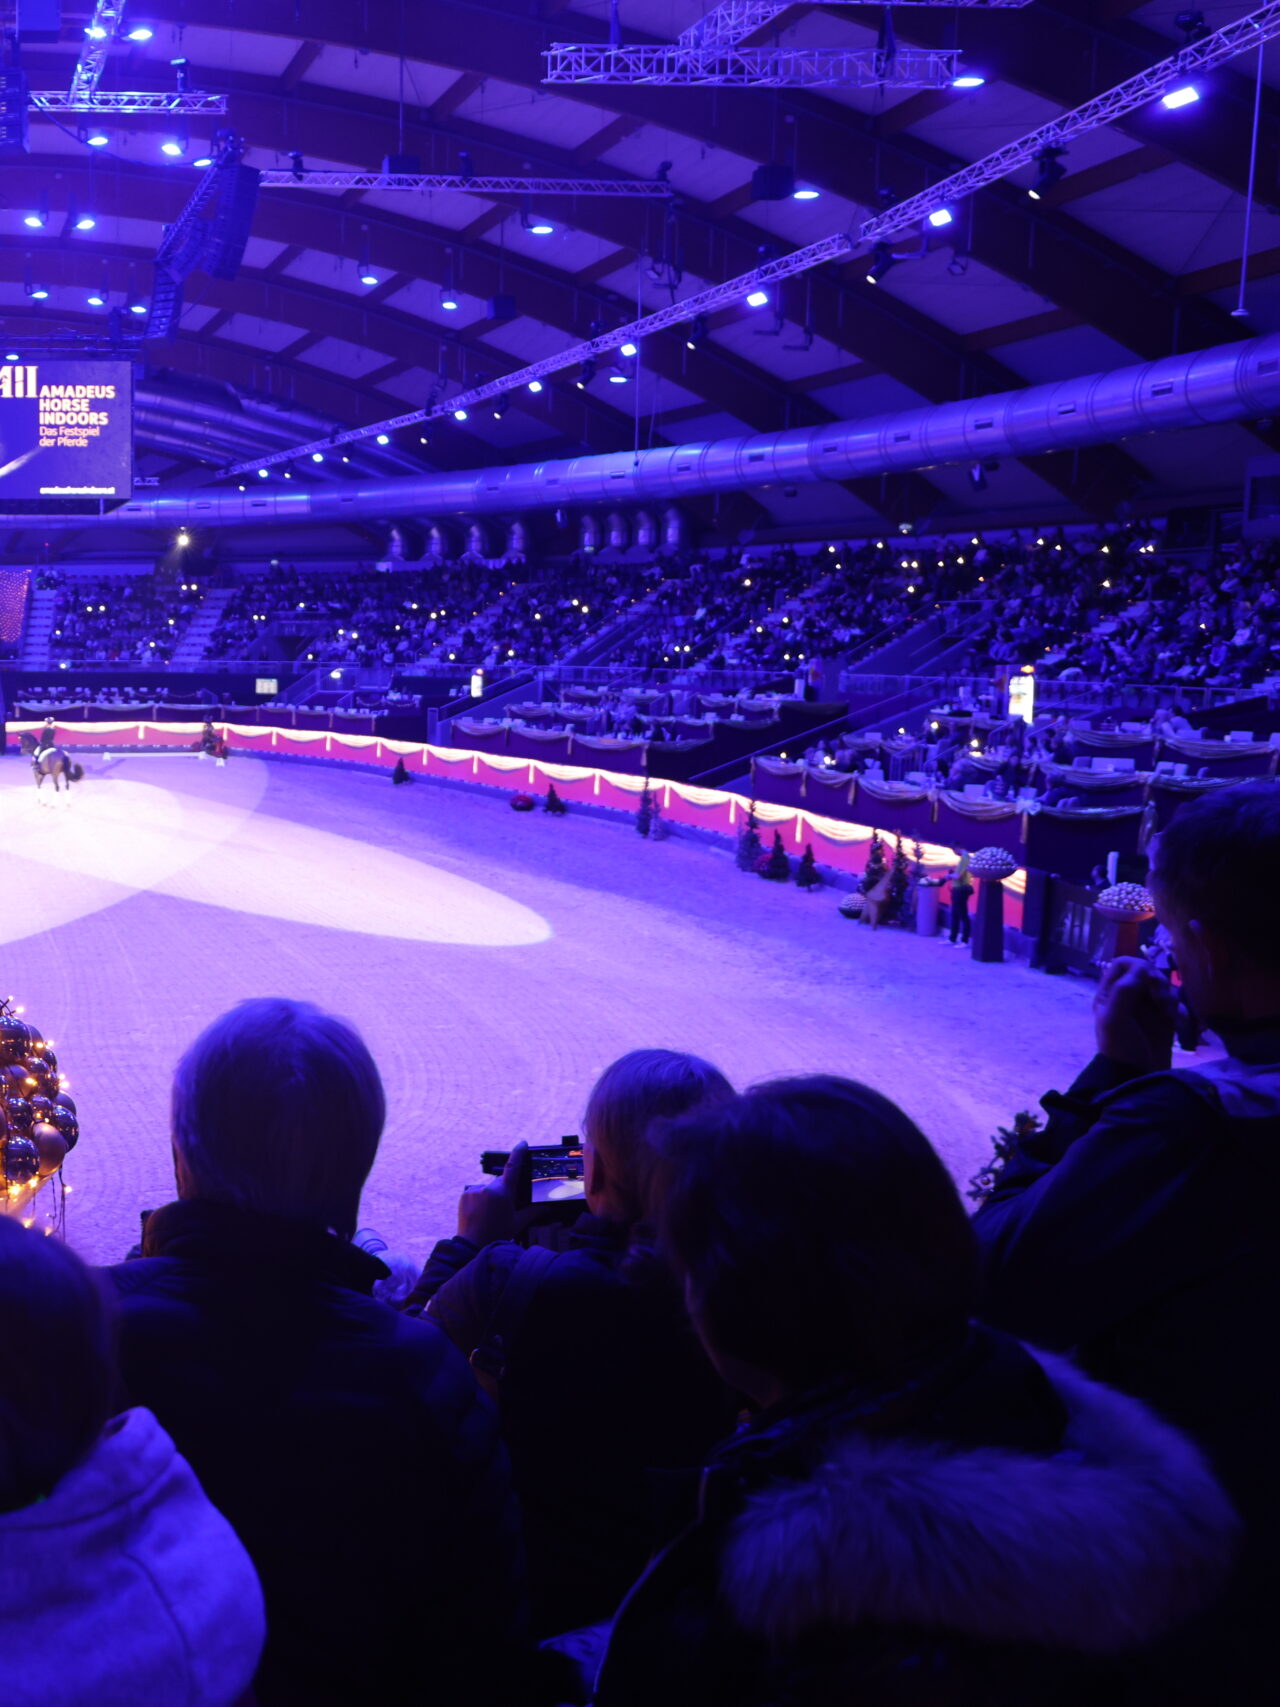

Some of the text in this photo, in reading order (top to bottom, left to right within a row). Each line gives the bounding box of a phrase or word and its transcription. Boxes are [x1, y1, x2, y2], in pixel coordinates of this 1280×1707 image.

[39, 385, 116, 398] AMADEUS
[39, 399, 90, 412] HORSE
[39, 412, 109, 425] INDOORS
[39, 426, 99, 438] Das Festspiel
[39, 436, 88, 446] der Pferde
